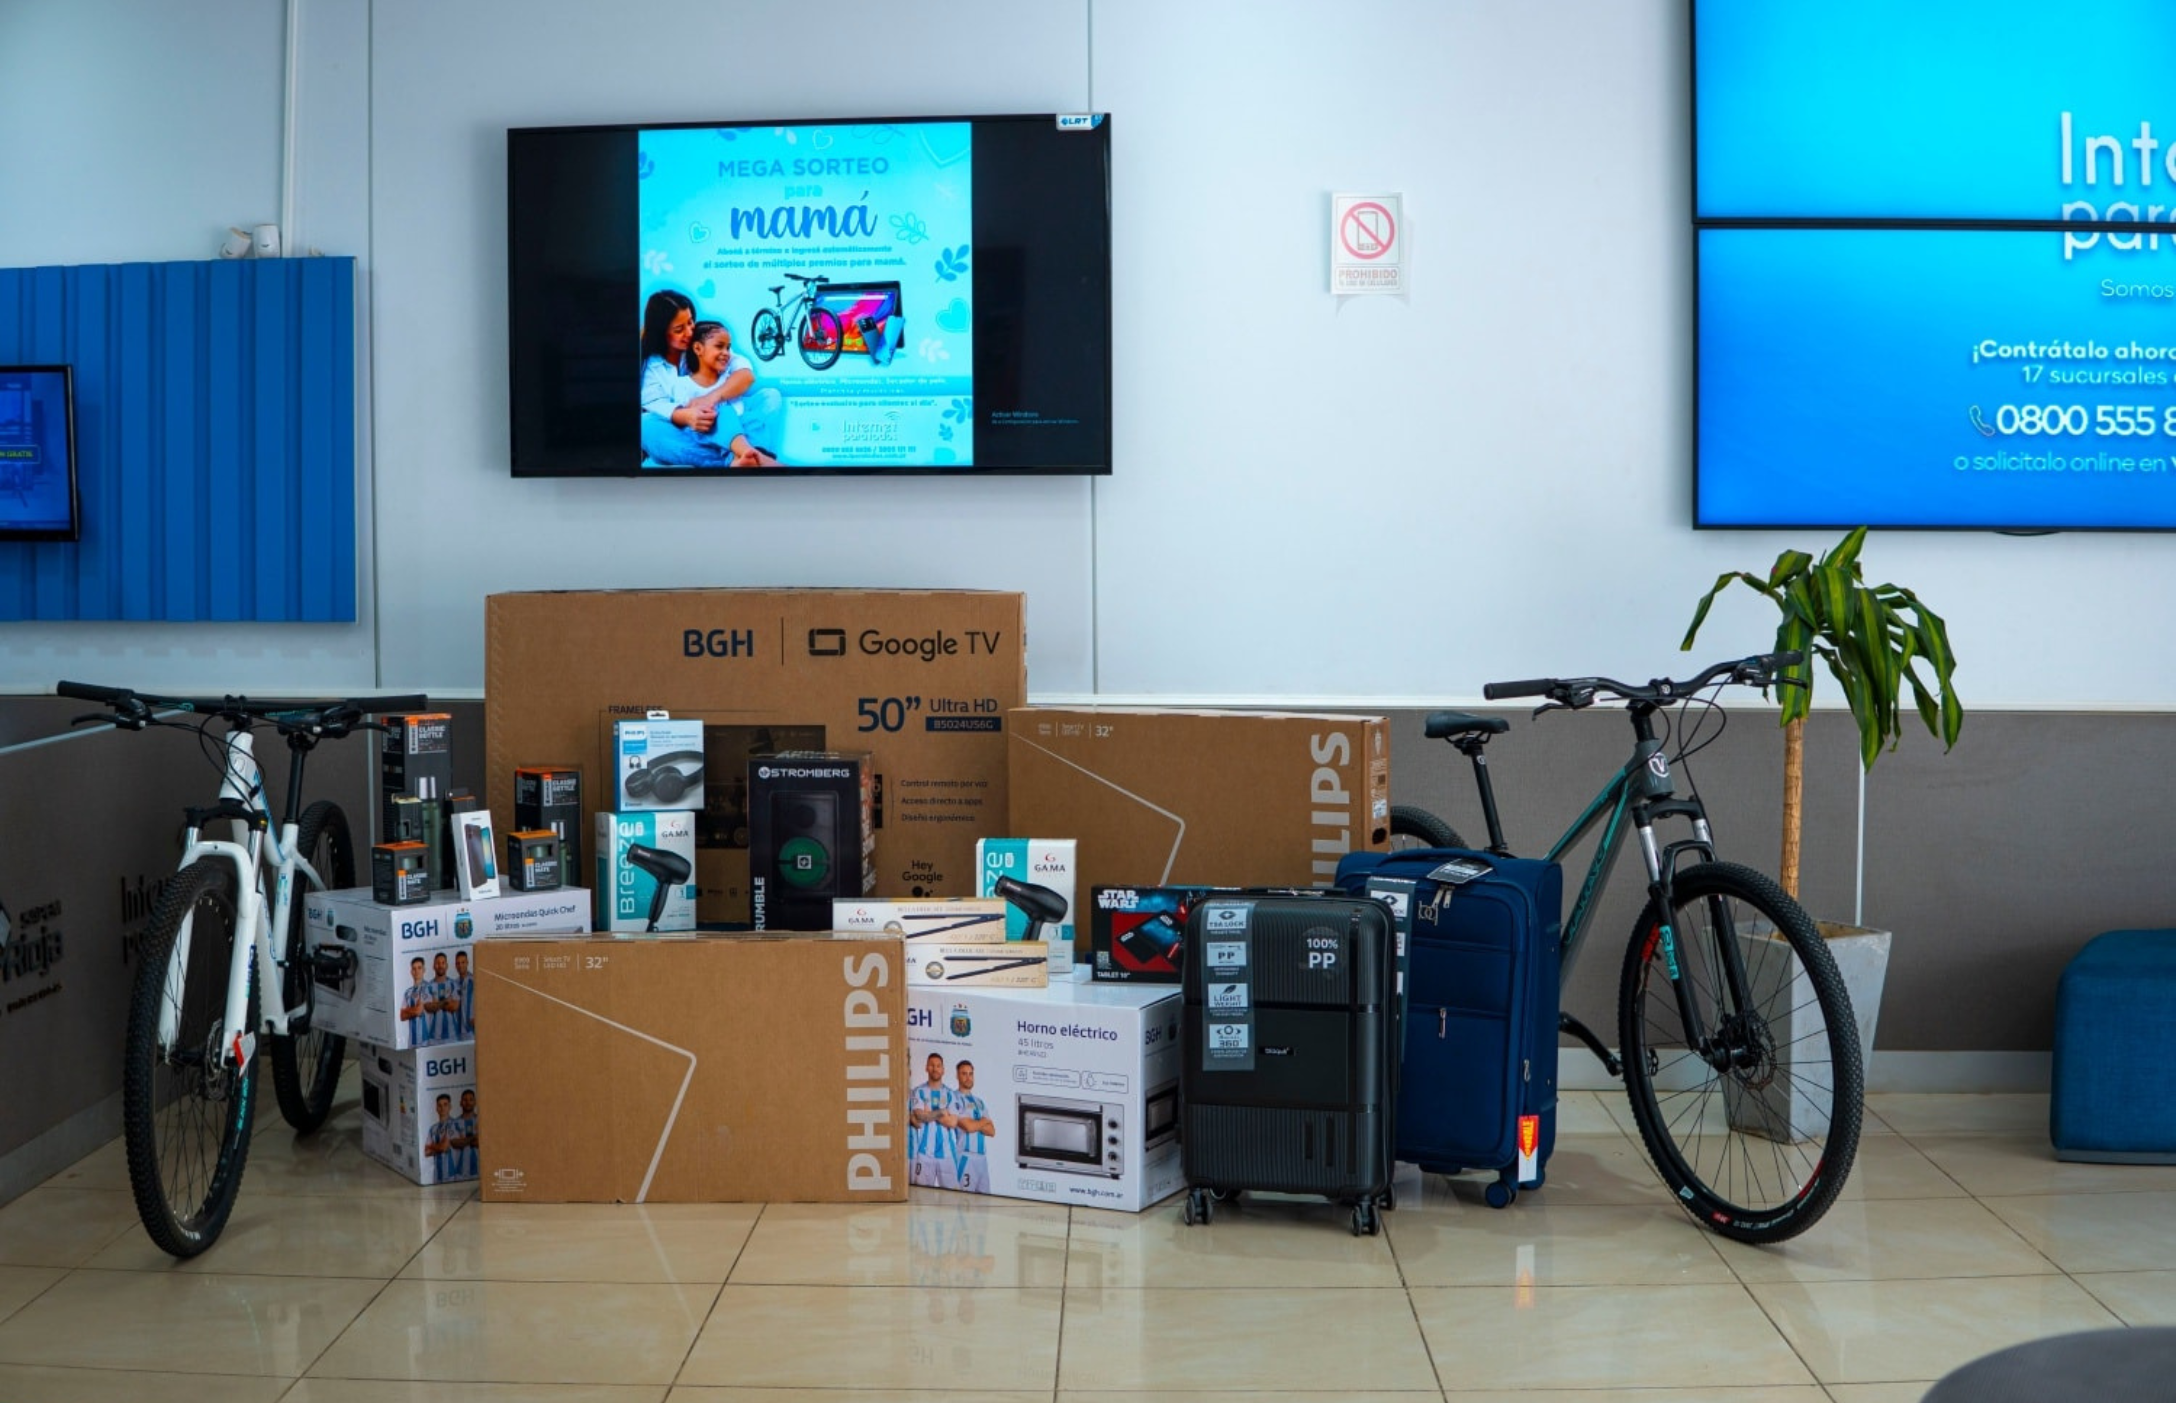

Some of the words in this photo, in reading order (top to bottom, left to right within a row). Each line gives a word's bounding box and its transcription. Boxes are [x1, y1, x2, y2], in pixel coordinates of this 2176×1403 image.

[2061, 112, 2176, 186] Int
[718, 160, 785, 177] MEGA
[793, 157, 889, 176] SORTEO
[785, 183, 823, 200] para
[730, 190, 878, 240] mamá
[2062, 201, 2176, 260] par
[714, 260, 745, 269] sorteo
[747, 260, 760, 269] de
[762, 258, 806, 269] múltiples
[808, 258, 848, 269] premios
[849, 258, 872, 268] para
[1338, 269, 1398, 279] PROHIBIDO
[2101, 278, 2174, 298] Somos
[1972, 339, 2109, 363] ¡Contrátalo
[2022, 365, 2044, 383] 17
[2049, 365, 2168, 384] sucursales
[843, 420, 898, 433] Internet
[1996, 405, 2089, 435] 0800
[2095, 405, 2156, 436] 555
[1954, 456, 1970, 471] o
[2069, 452, 2135, 472] online
[2139, 457, 2167, 471] en
[683, 629, 754, 657] BGH
[859, 630, 958, 662] Google
[964, 631, 1001, 655] TV
[930, 699, 969, 713] Ultra
[973, 699, 998, 713] HD
[769, 768, 850, 778] STROMBERG
[1310, 732, 1350, 888] ILIPS
[619, 821, 635, 914] Breeze
[911, 860, 933, 872] Hey
[902, 871, 943, 884] Google
[1098, 889, 1139, 899] STAR
[1098, 898, 1140, 909] WARS
[308, 908, 322, 919] BGH
[494, 909, 538, 921] Microondas
[539, 906, 559, 917] Quick
[560, 905, 576, 914] Chef
[401, 919, 439, 940] BGH
[1307, 938, 1338, 949] 100%
[1309, 952, 1336, 969] PP
[1097, 971, 1119, 979] TABLET
[1016, 1020, 1057, 1036] Horno
[1060, 1022, 1118, 1041] eléctrico
[1018, 1037, 1030, 1047] 45
[1031, 1038, 1054, 1050] litros
[426, 1057, 466, 1077] BGH
[843, 952, 892, 1190] PHILIPS
[1069, 1185, 1124, 1199] www.bgh.com.ar
